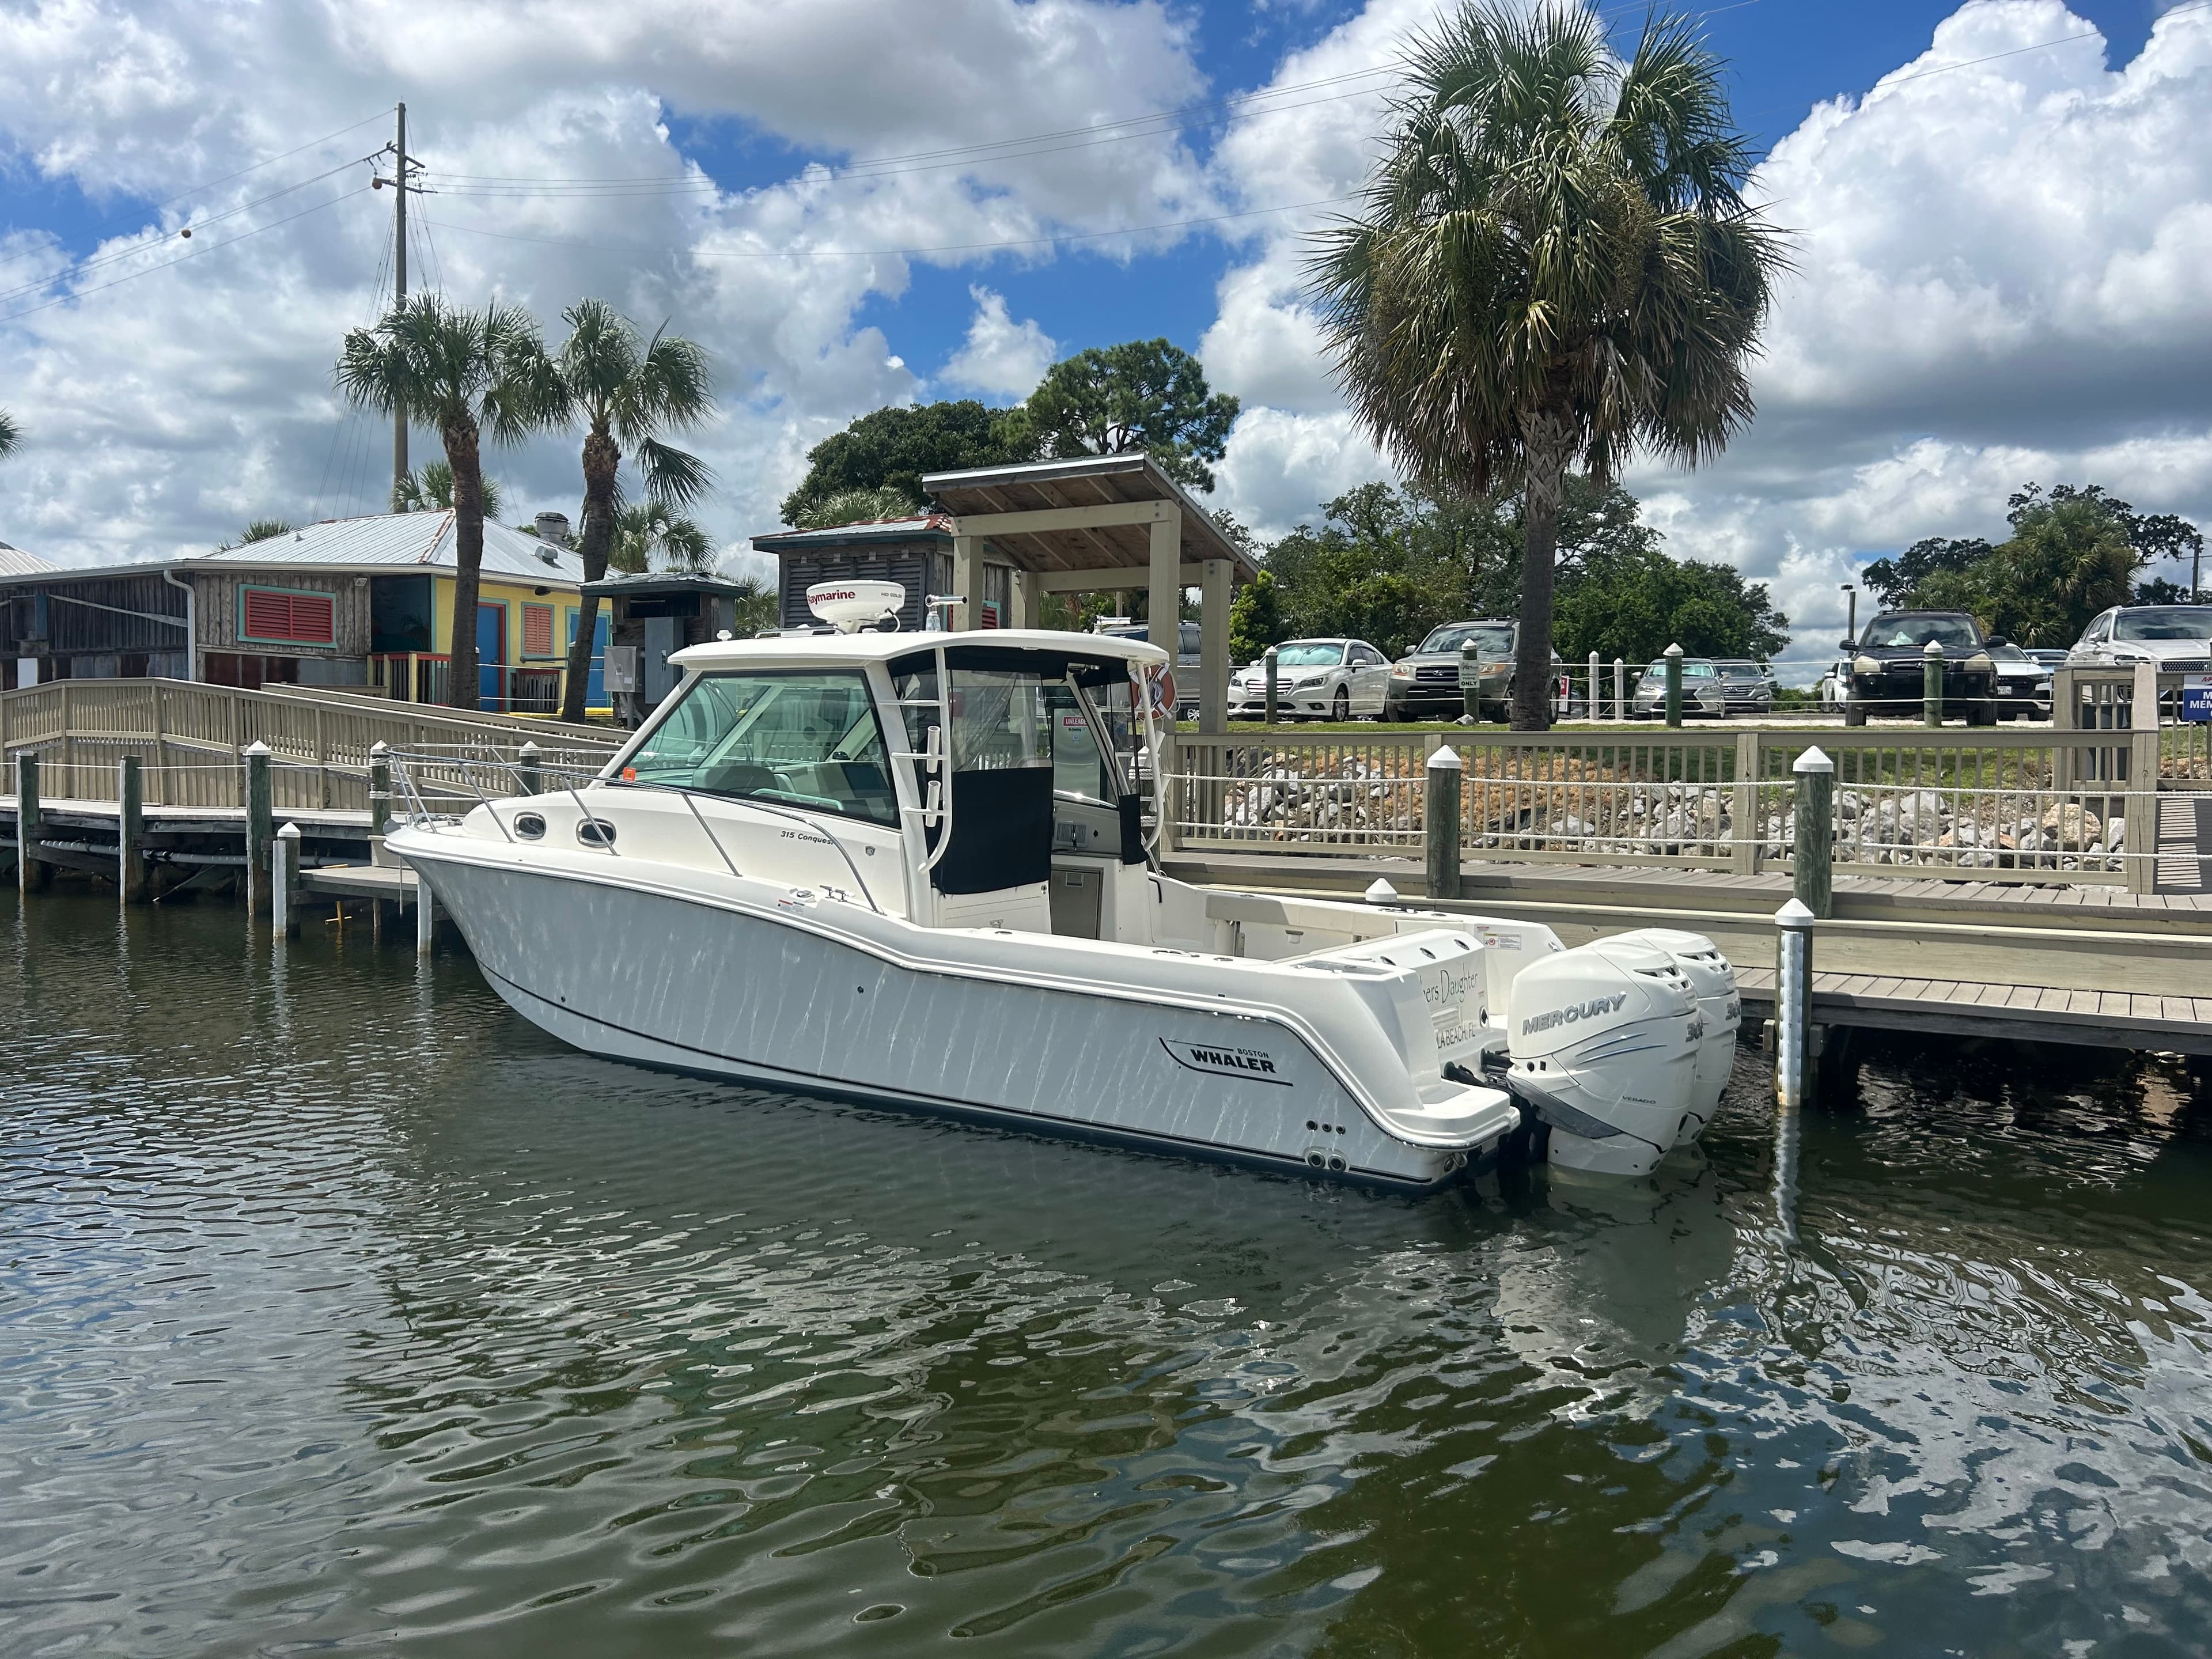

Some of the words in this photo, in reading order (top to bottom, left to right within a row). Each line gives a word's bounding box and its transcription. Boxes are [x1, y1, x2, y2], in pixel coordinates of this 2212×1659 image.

[781, 831, 795, 839] 315
[1440, 963, 1478, 1003] Daughter
[1522, 991, 1627, 1036] MERCURY
[1468, 1022, 1475, 1038] FL
[1190, 1048, 1277, 1073] WHALER
[1237, 1048, 1269, 1059] BOSTON
[1622, 1096, 1656, 1104] VERADO
